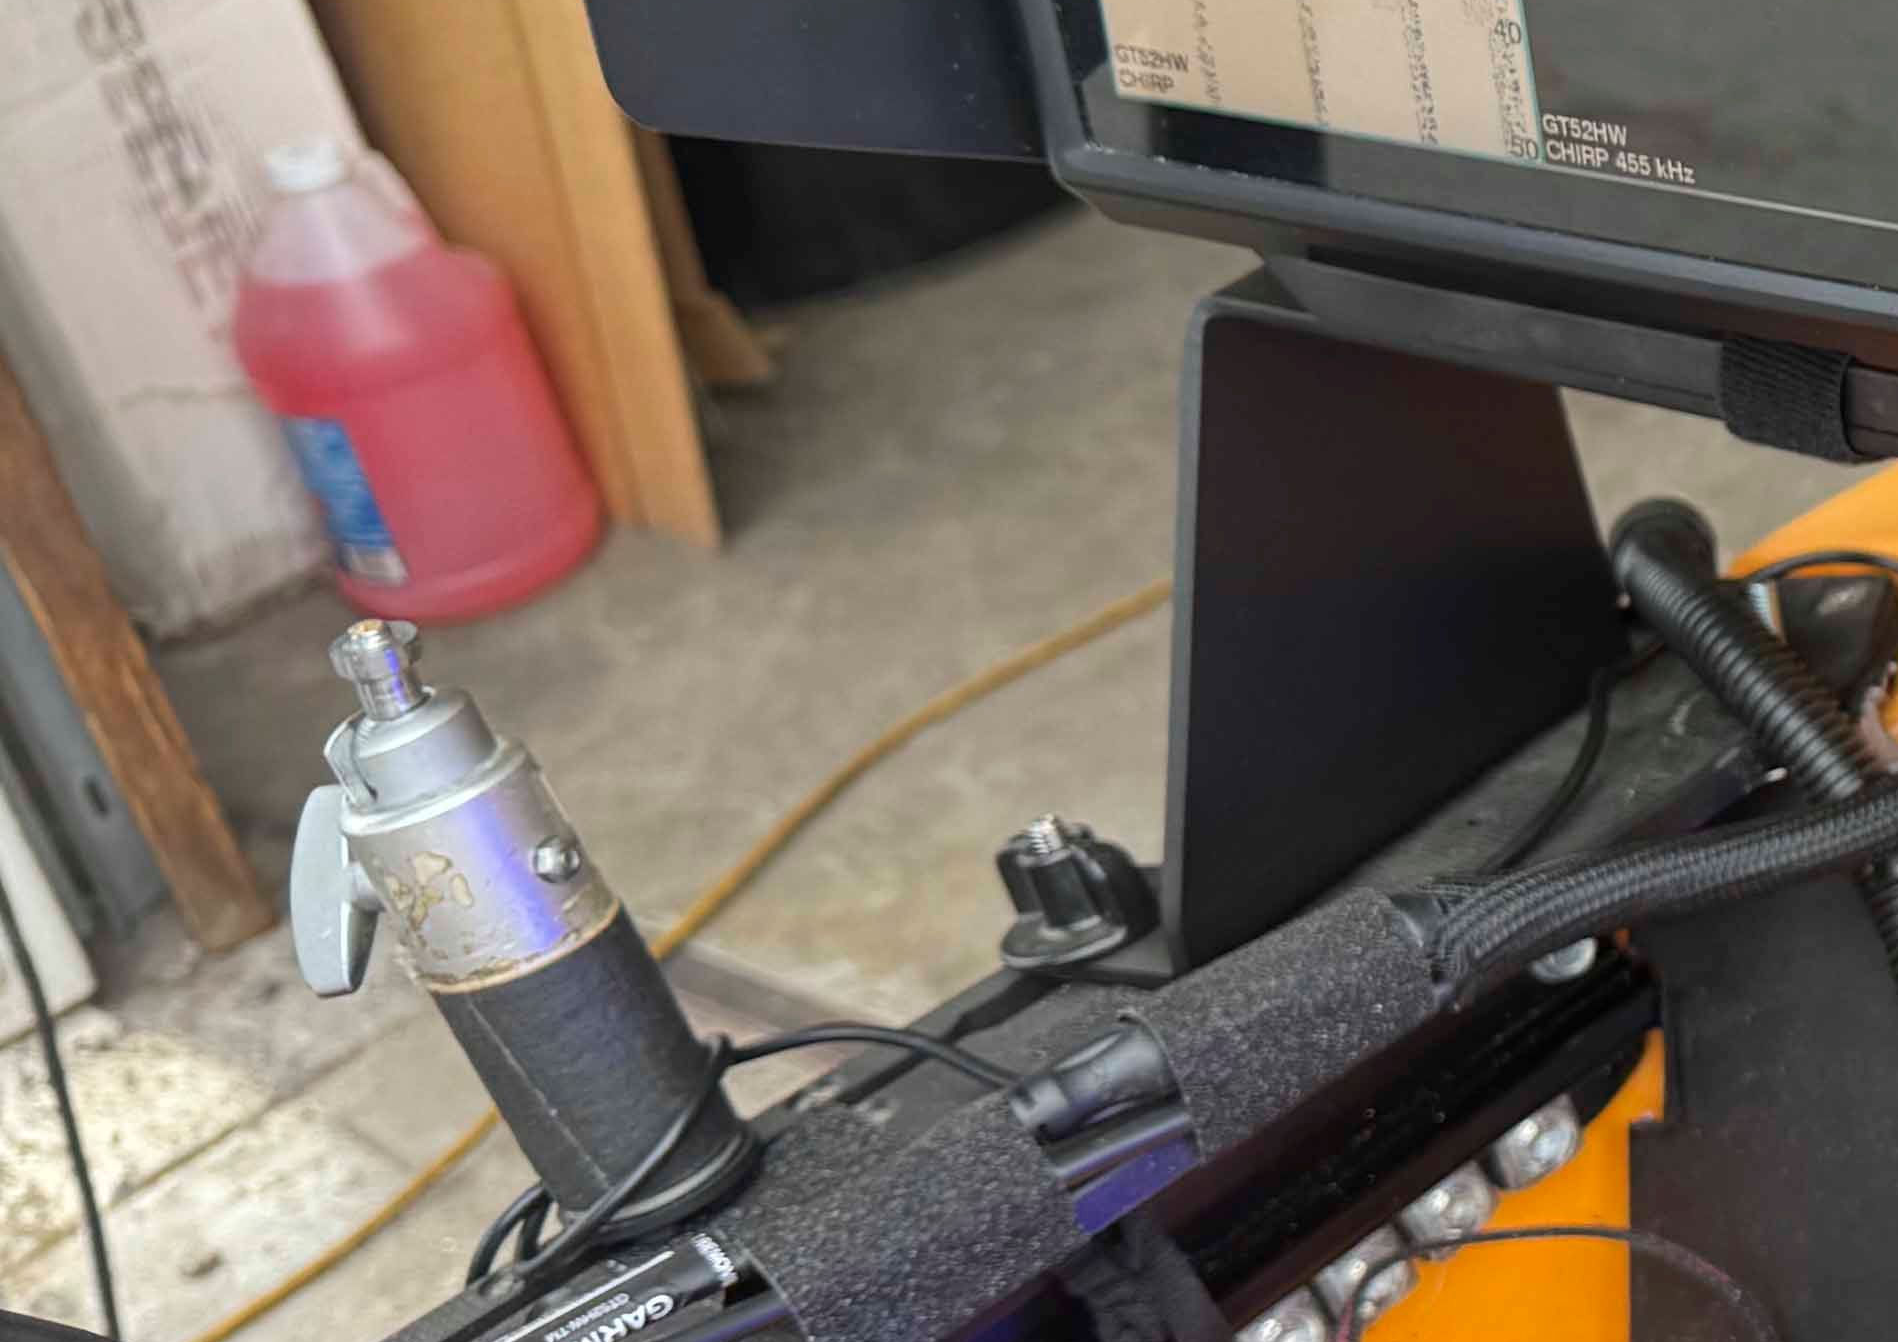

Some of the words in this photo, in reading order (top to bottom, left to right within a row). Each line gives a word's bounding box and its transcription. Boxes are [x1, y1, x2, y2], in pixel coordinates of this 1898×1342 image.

[1494, 21, 1522, 45] 40
[1543, 113, 1627, 146] GT52HW
[1546, 139, 1609, 168] CHIRP
[1615, 151, 1651, 176] 455
[1655, 158, 1696, 184] kHz
